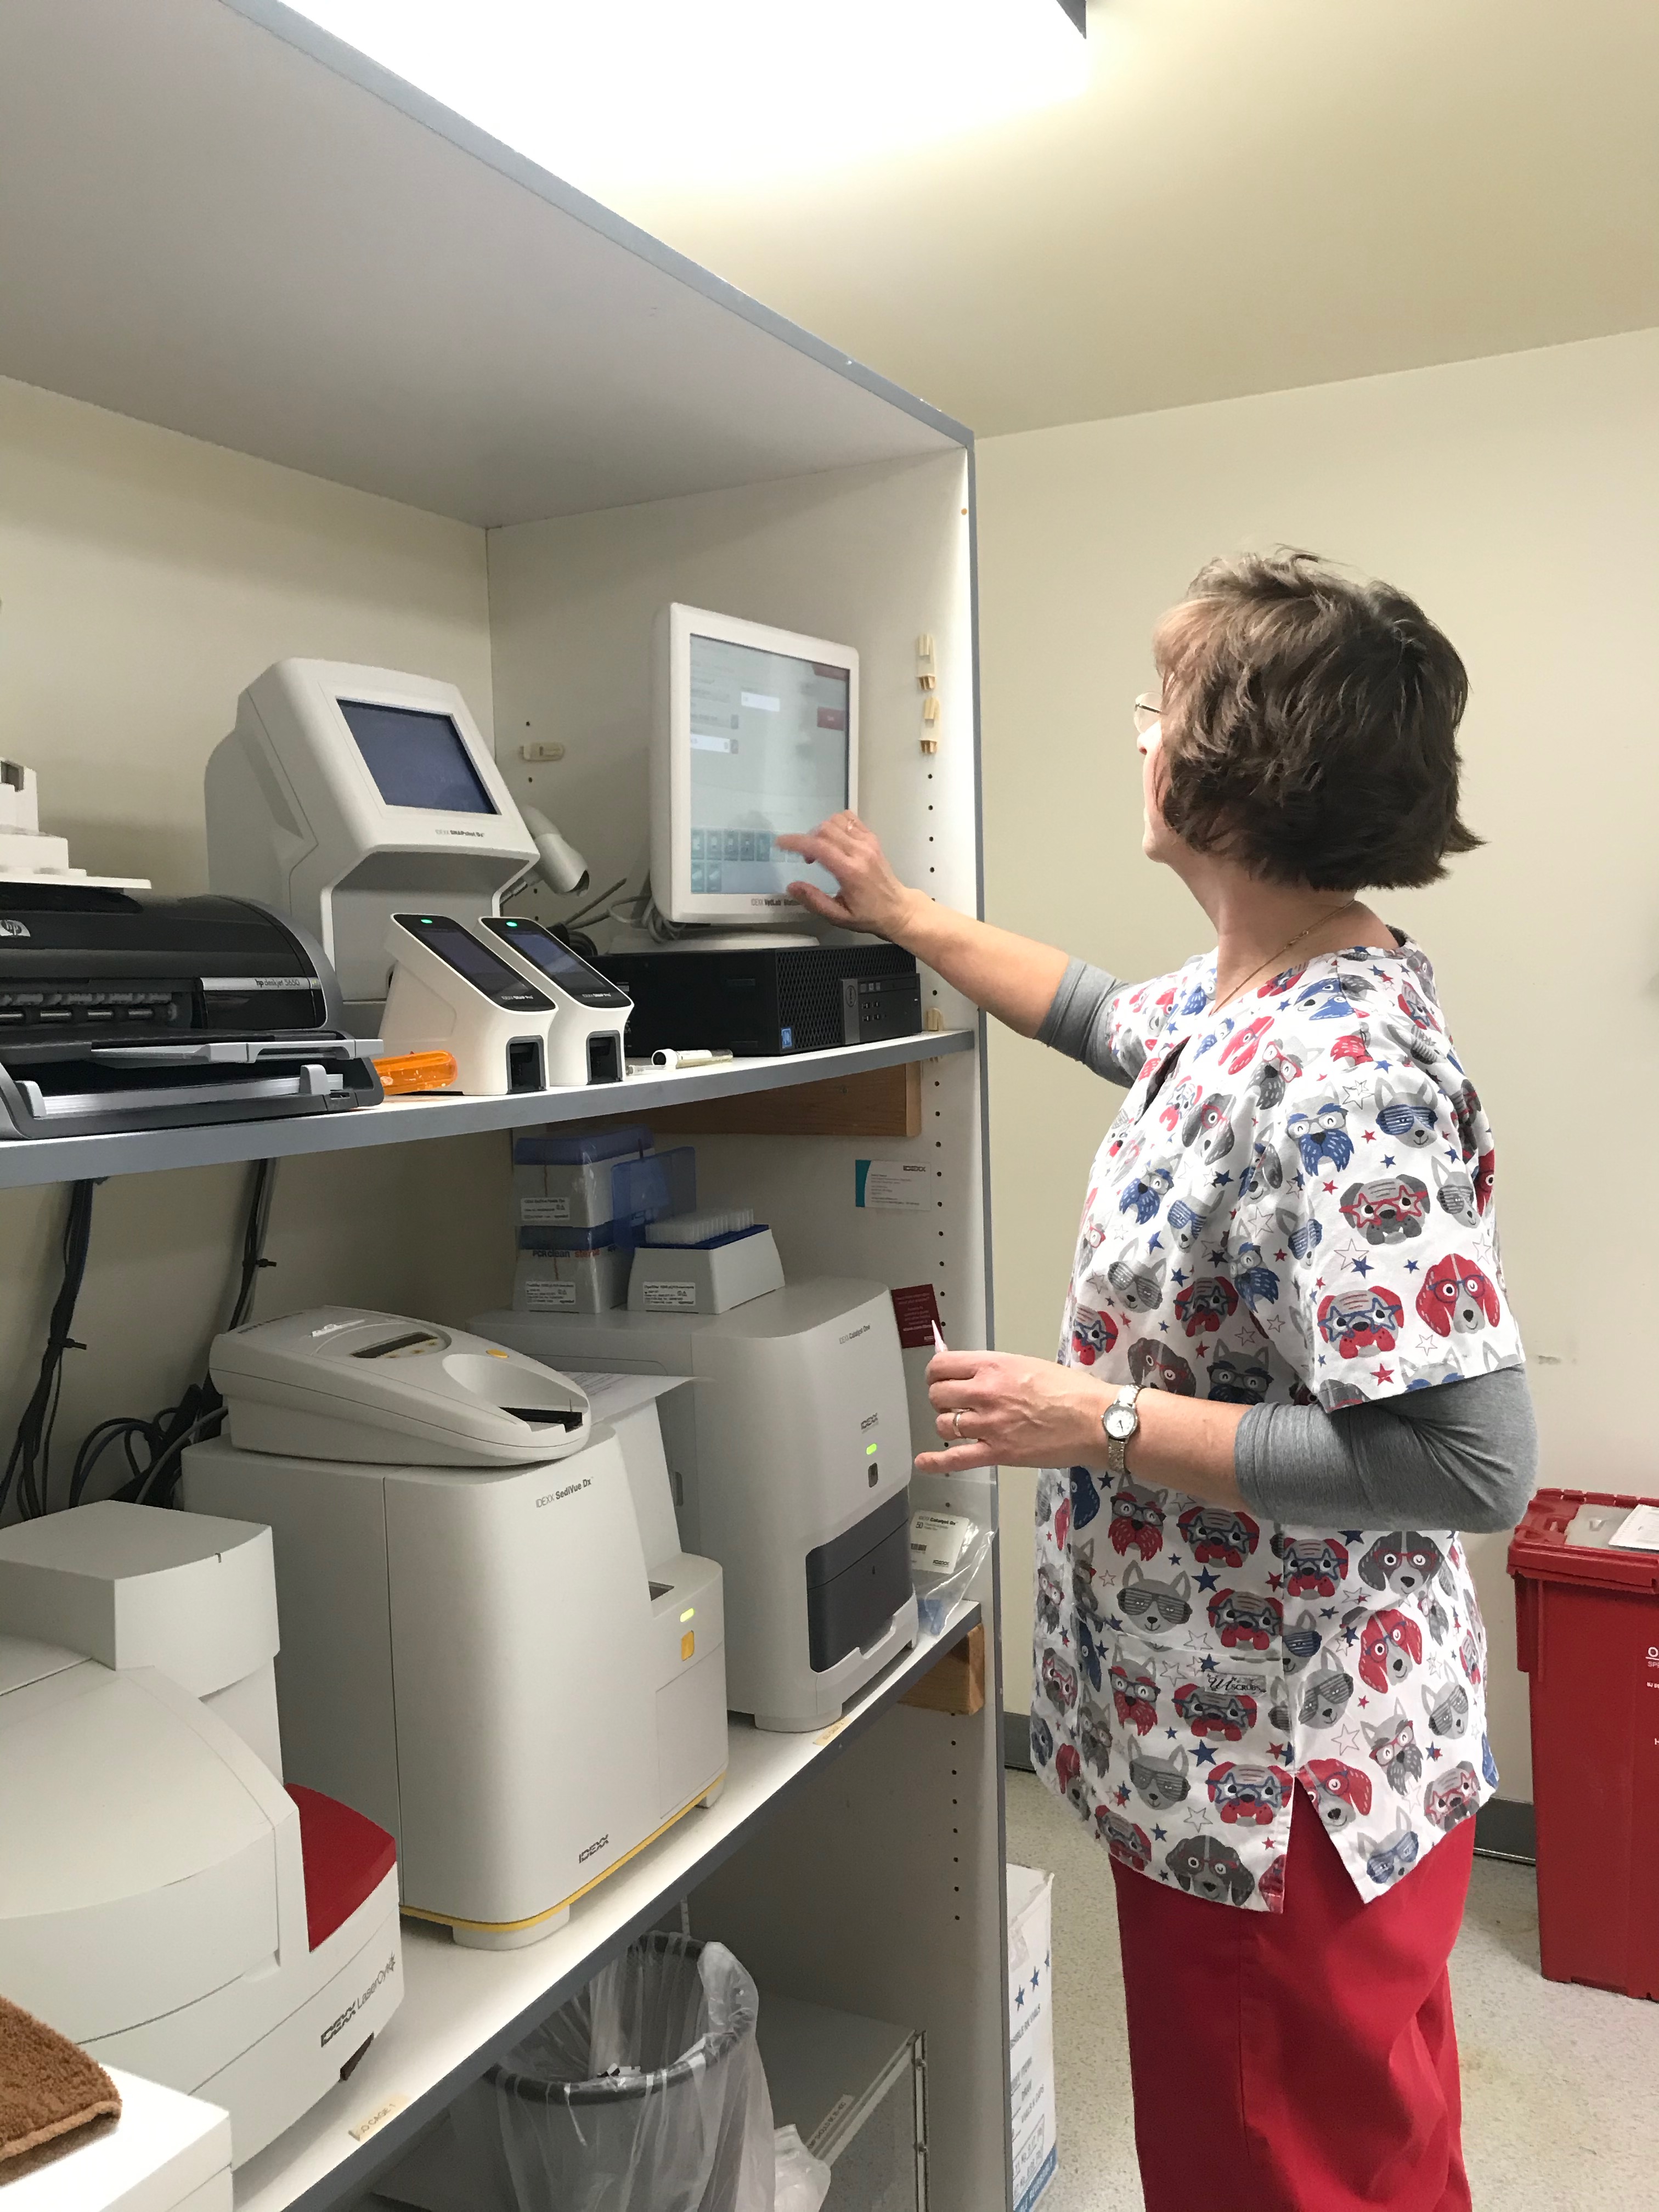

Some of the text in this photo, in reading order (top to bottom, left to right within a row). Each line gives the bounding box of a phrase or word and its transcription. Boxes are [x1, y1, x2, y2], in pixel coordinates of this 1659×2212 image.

[4, 919, 19, 935] hp
[255, 978, 264, 988] hp
[264, 978, 283, 988] deskjet
[849, 1327, 863, 1339] Catalyst
[861, 1412, 878, 1430] IDEXX
[535, 1479, 591, 1508] IDEXX SediVue Dx
[579, 1833, 609, 1864] IDEXX
[320, 2000, 356, 2048] IDEXX
